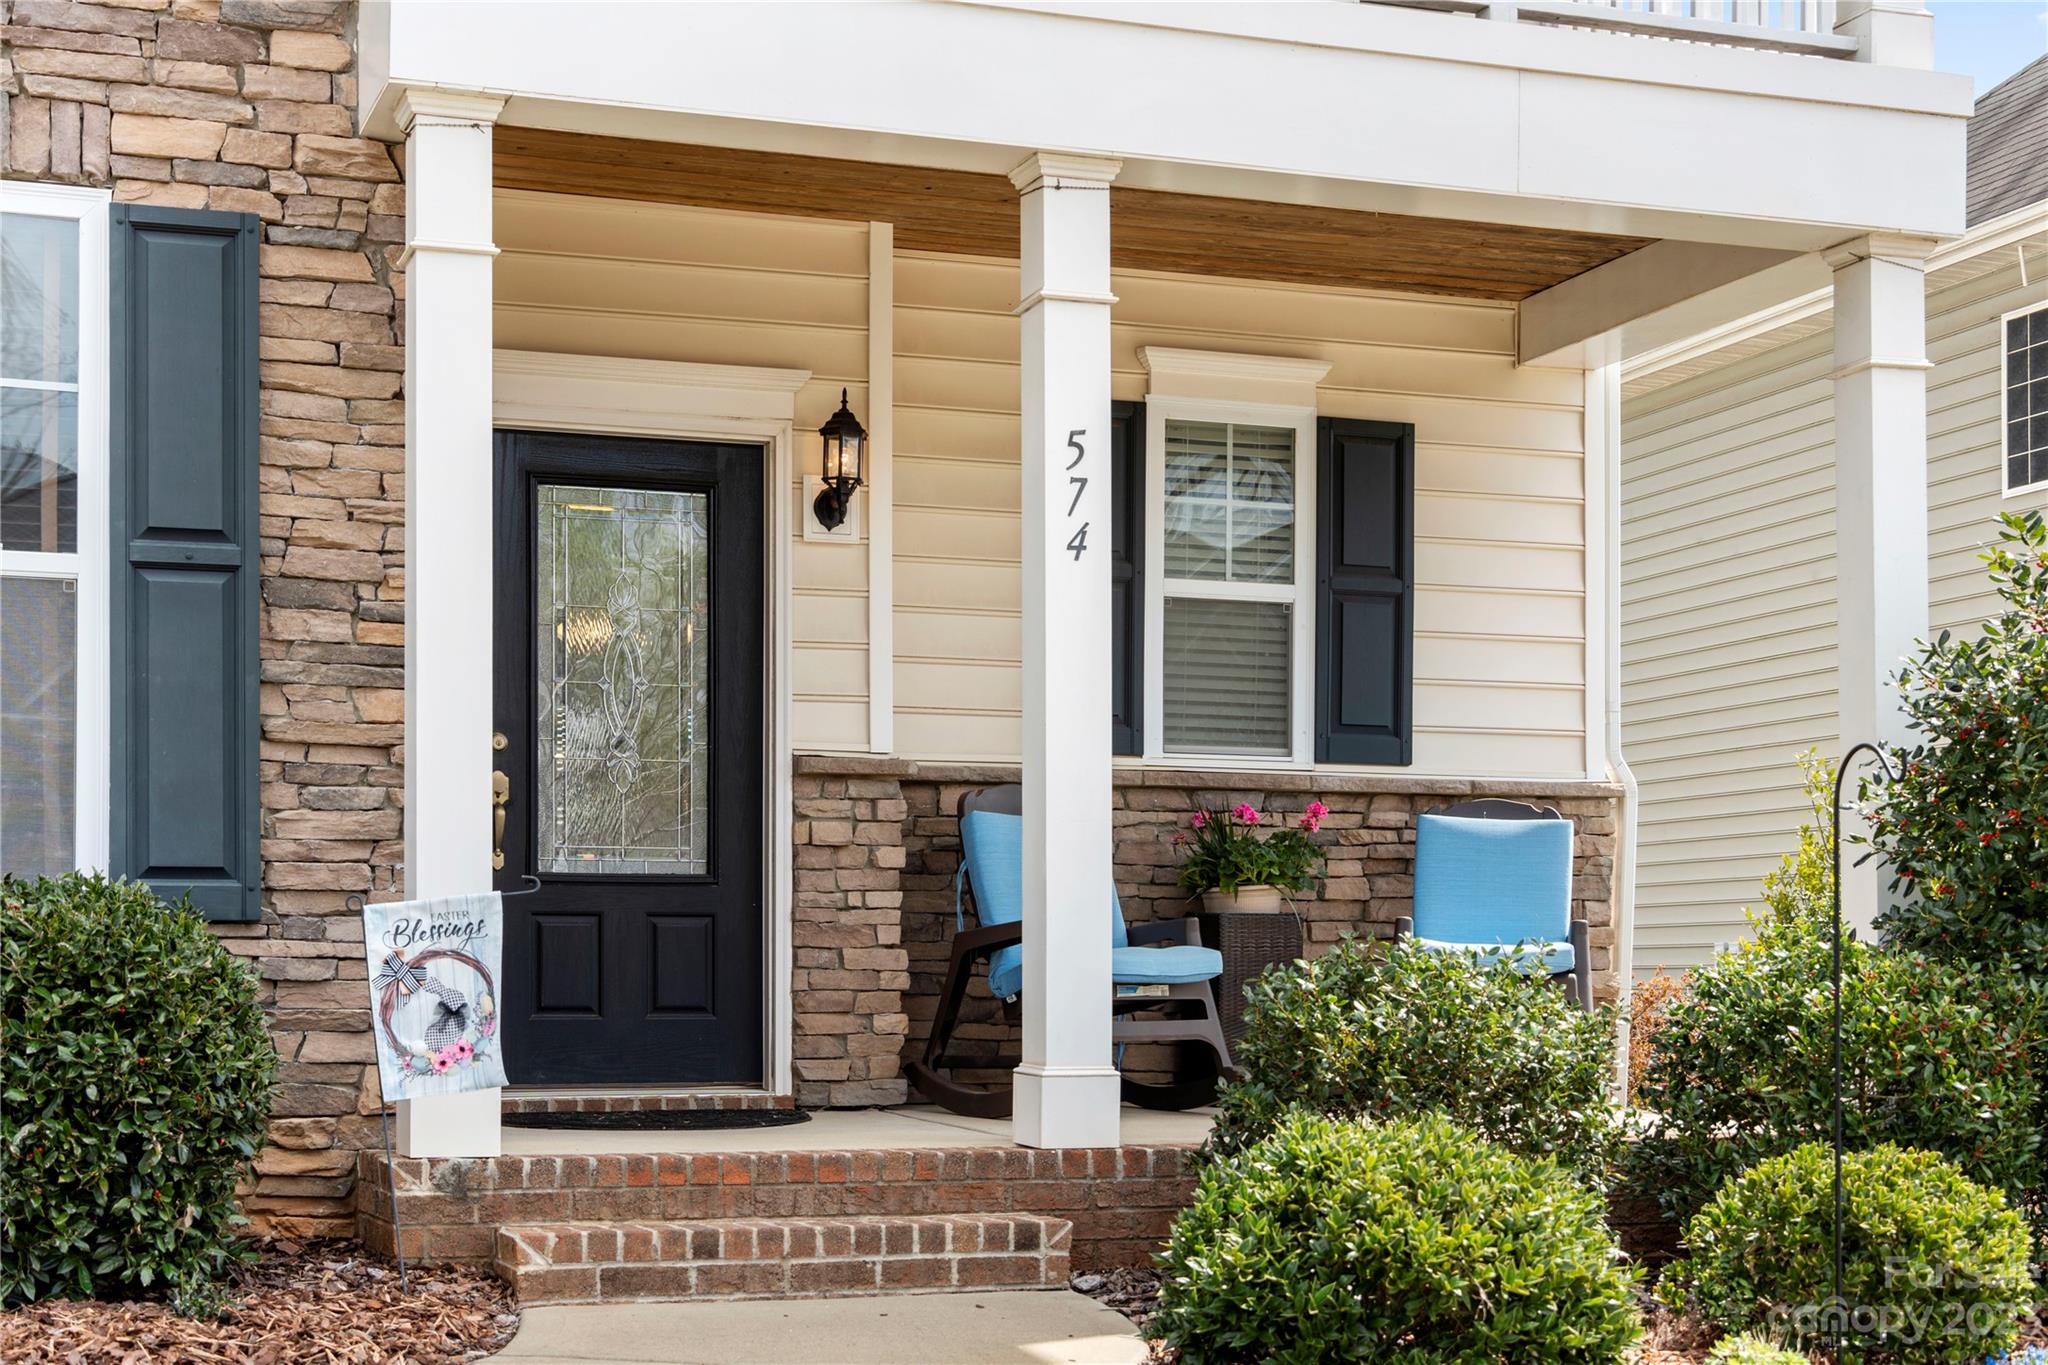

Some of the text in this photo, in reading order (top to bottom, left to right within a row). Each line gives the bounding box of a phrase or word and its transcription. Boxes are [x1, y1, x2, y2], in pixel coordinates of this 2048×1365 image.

[1066, 429, 1090, 561] 574
[430, 910, 470, 922] EASTER
[383, 918, 488, 951] Blessings
